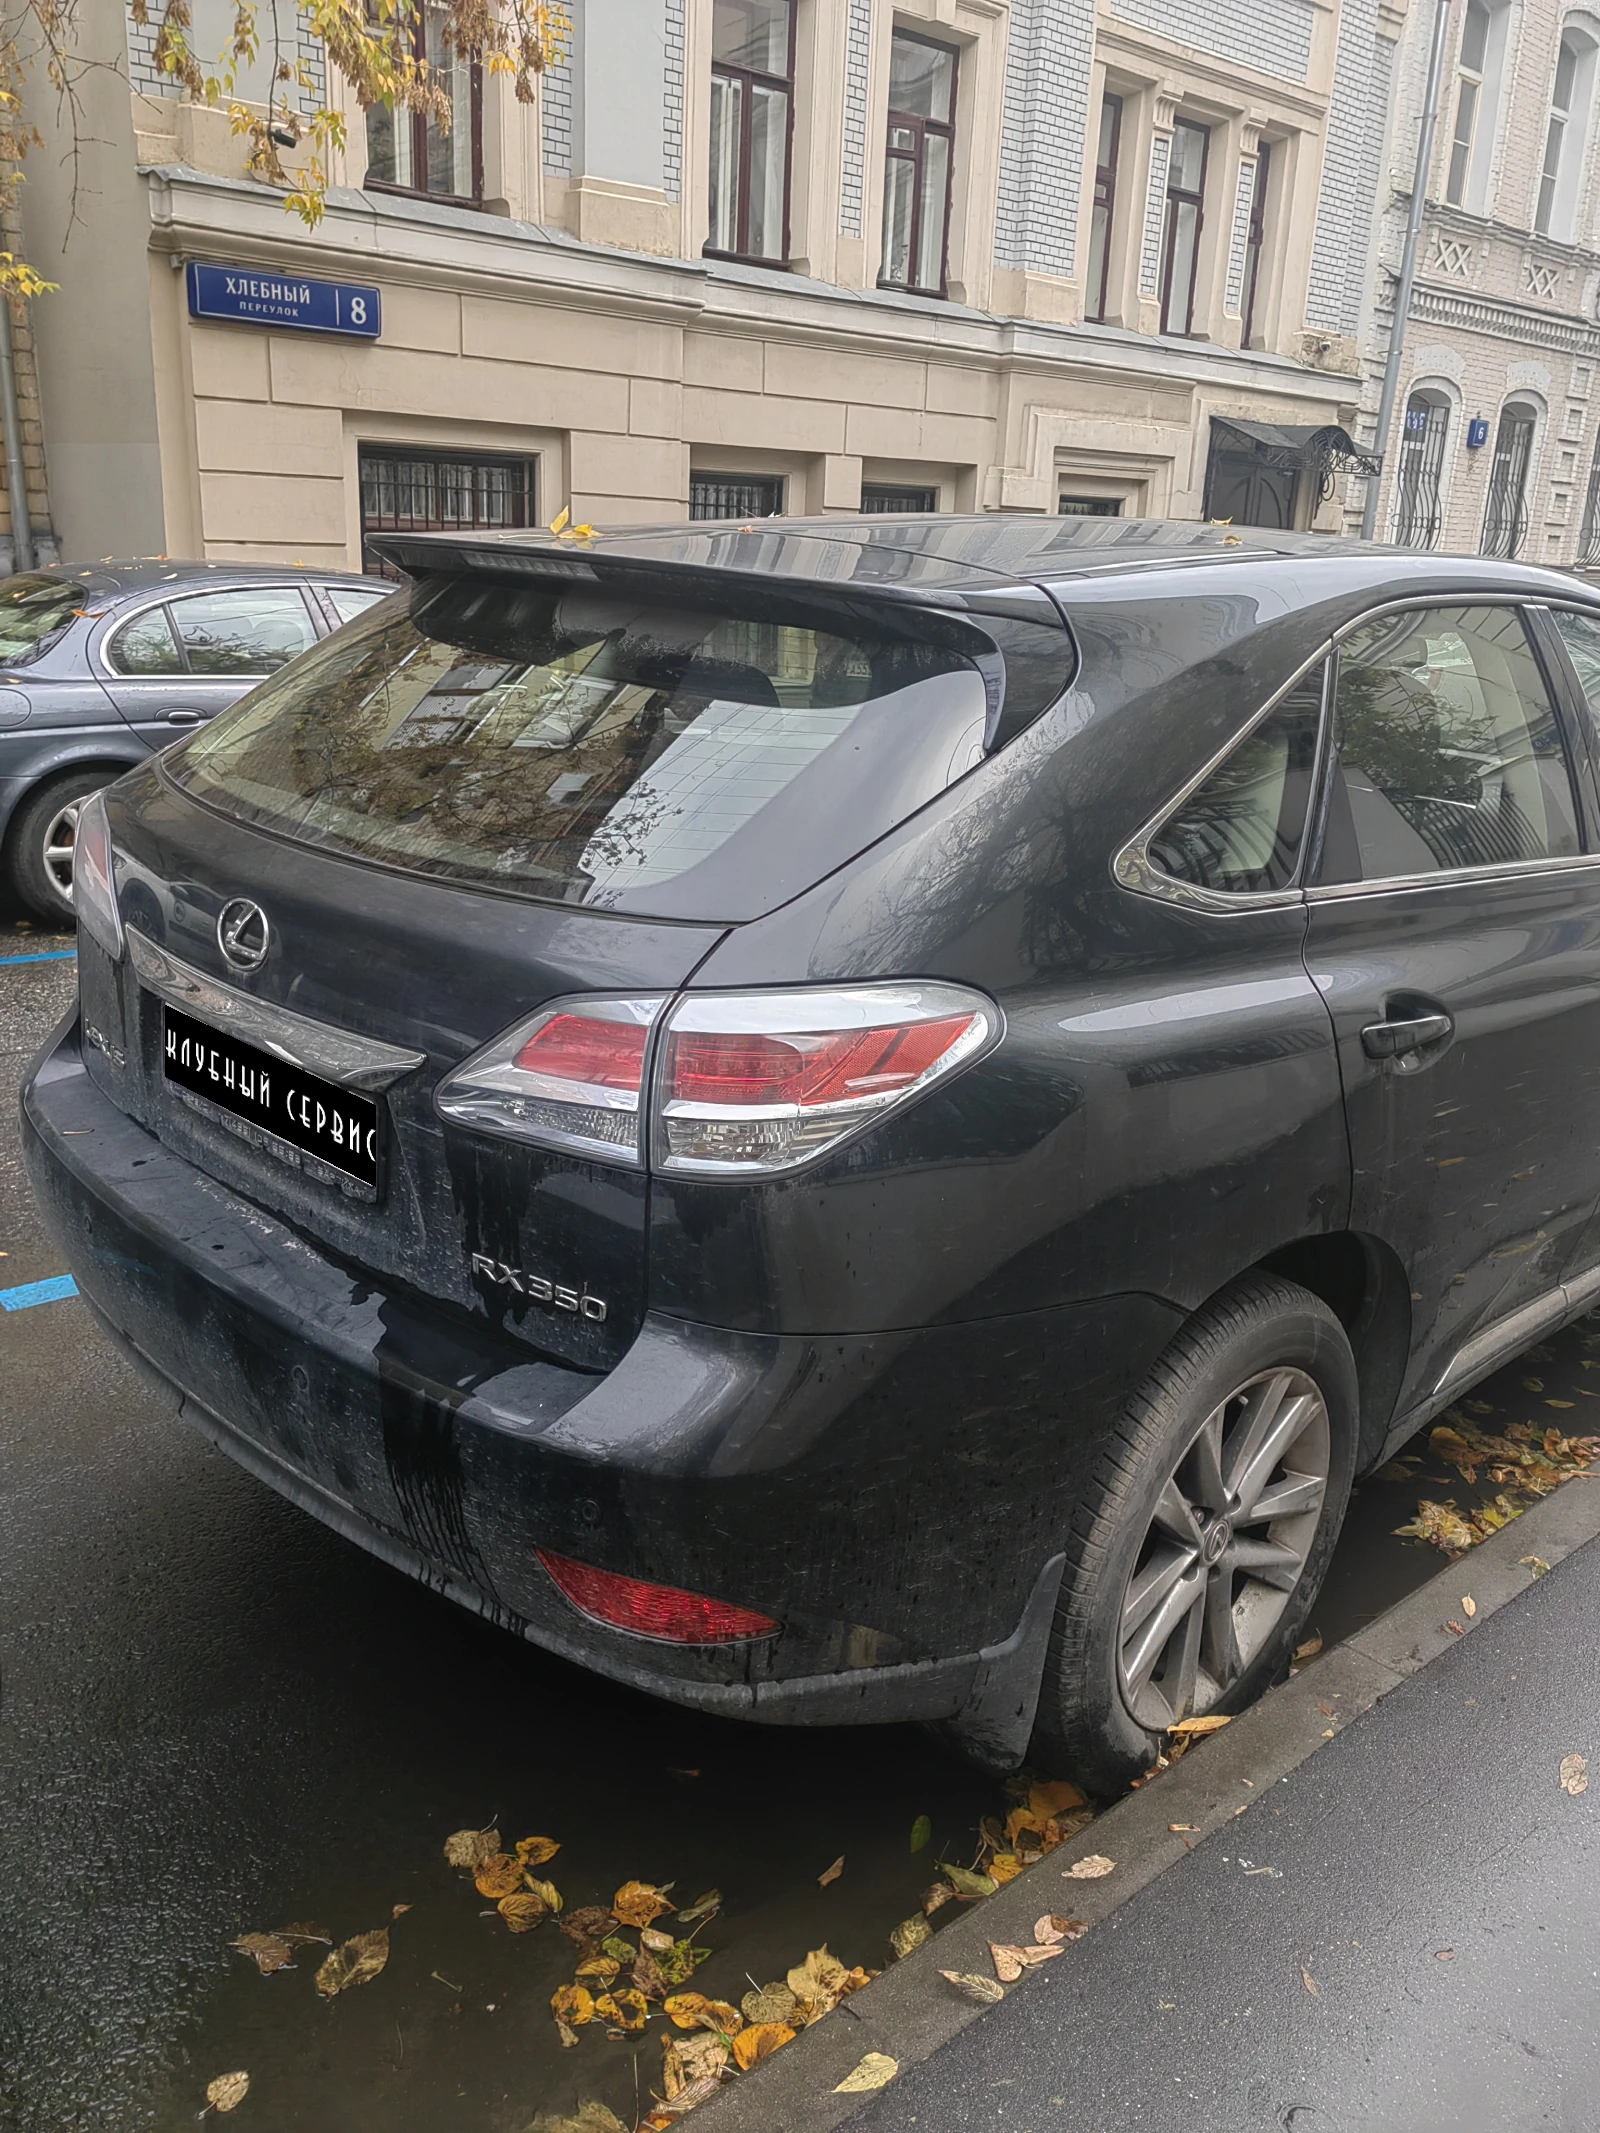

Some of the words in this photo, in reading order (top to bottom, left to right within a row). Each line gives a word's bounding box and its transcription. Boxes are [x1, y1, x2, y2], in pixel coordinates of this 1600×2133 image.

[225, 277, 310, 304] ХЛЕБНЫЙ
[239, 301, 299, 318] ПЕРЕУЛОК
[351, 297, 367, 325] 8
[1478, 427, 1484, 440] 6
